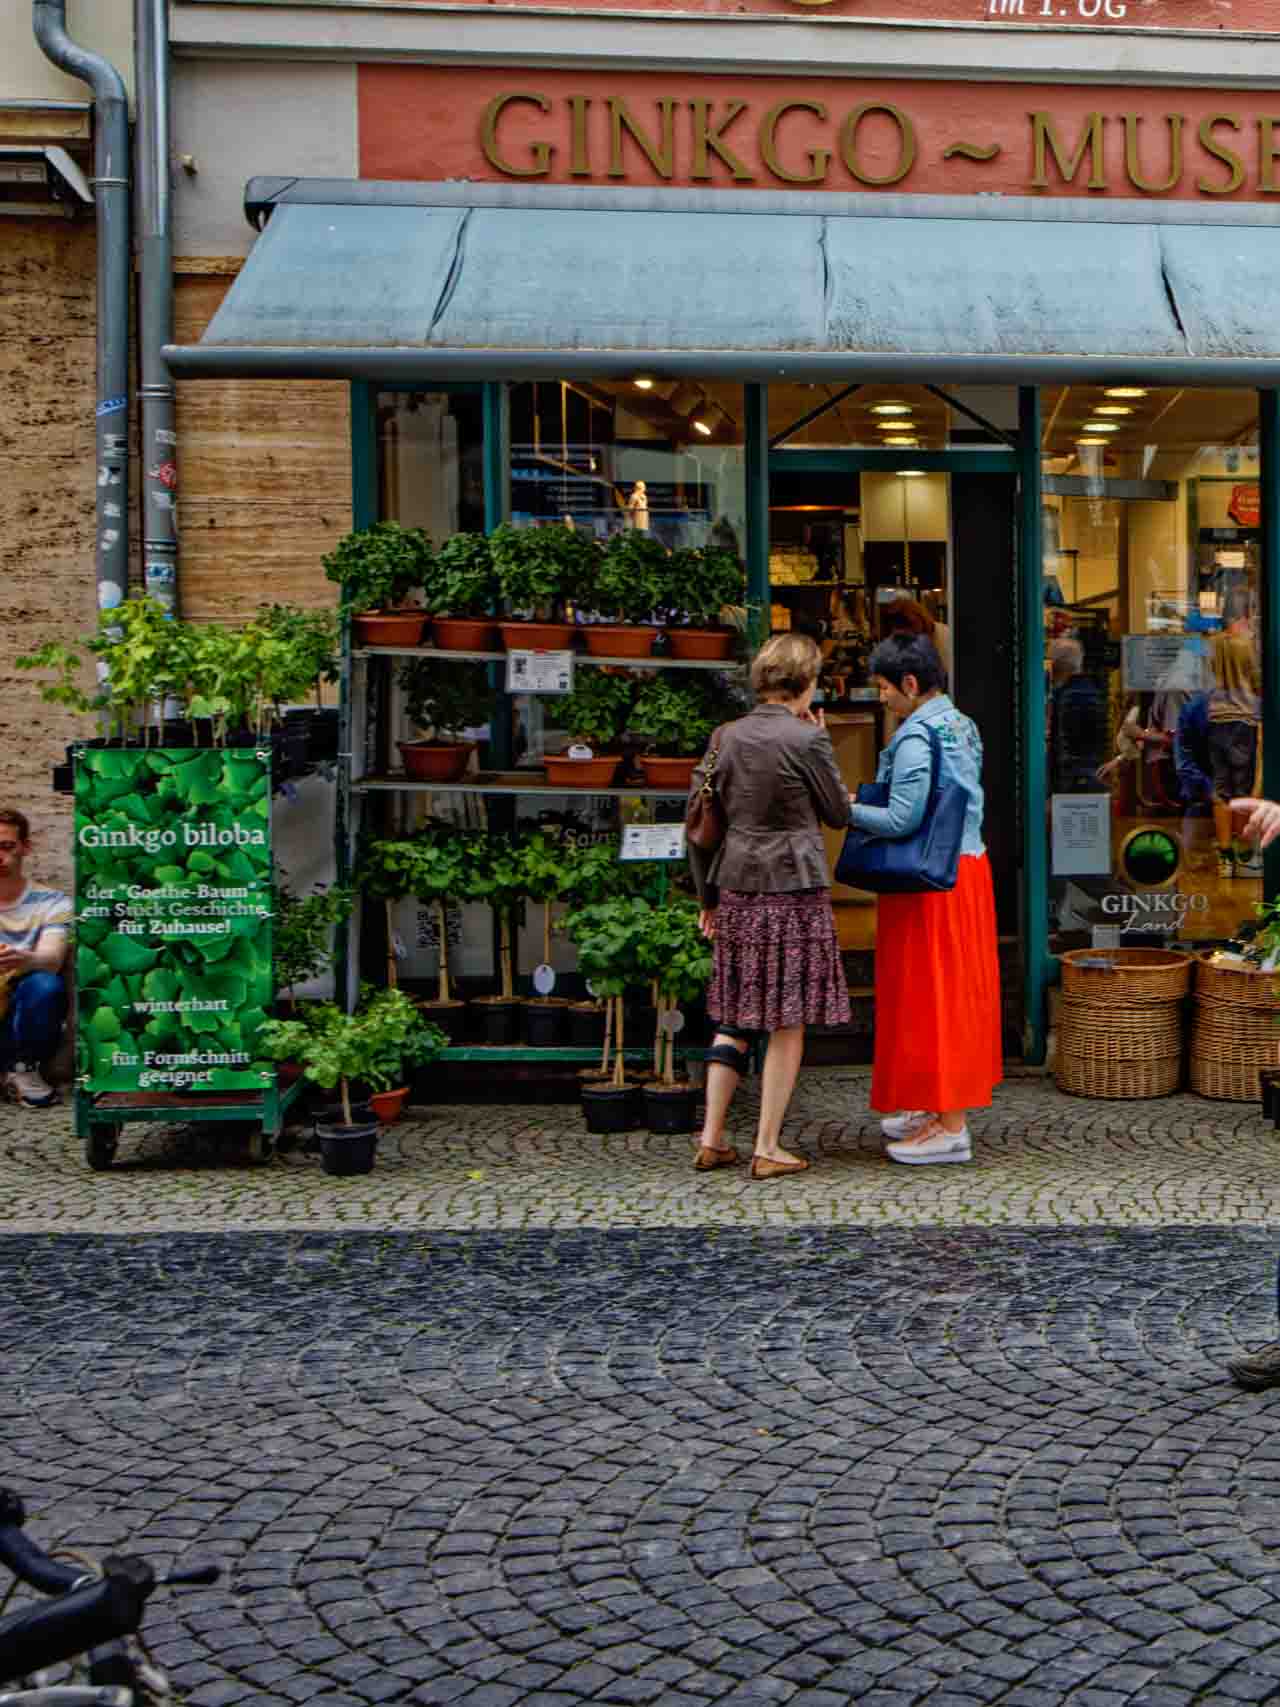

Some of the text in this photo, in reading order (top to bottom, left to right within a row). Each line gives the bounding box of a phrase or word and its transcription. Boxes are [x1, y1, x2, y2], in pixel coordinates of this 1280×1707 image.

[1077, 0, 1127, 18] OG
[481, 92, 918, 187] GINKGO
[79, 823, 265, 853] Ginkgo biloba
[86, 884, 115, 900] der
[114, 902, 165, 917] Stück
[1102, 894, 1209, 914] GINKGO
[118, 919, 231, 935] für Zuhause!
[1120, 910, 1185, 934] Land
[133, 997, 228, 1013] winterhart
[112, 1050, 140, 1065] für
[144, 1049, 251, 1069] Formschnitt
[138, 1069, 213, 1087] geeignet
